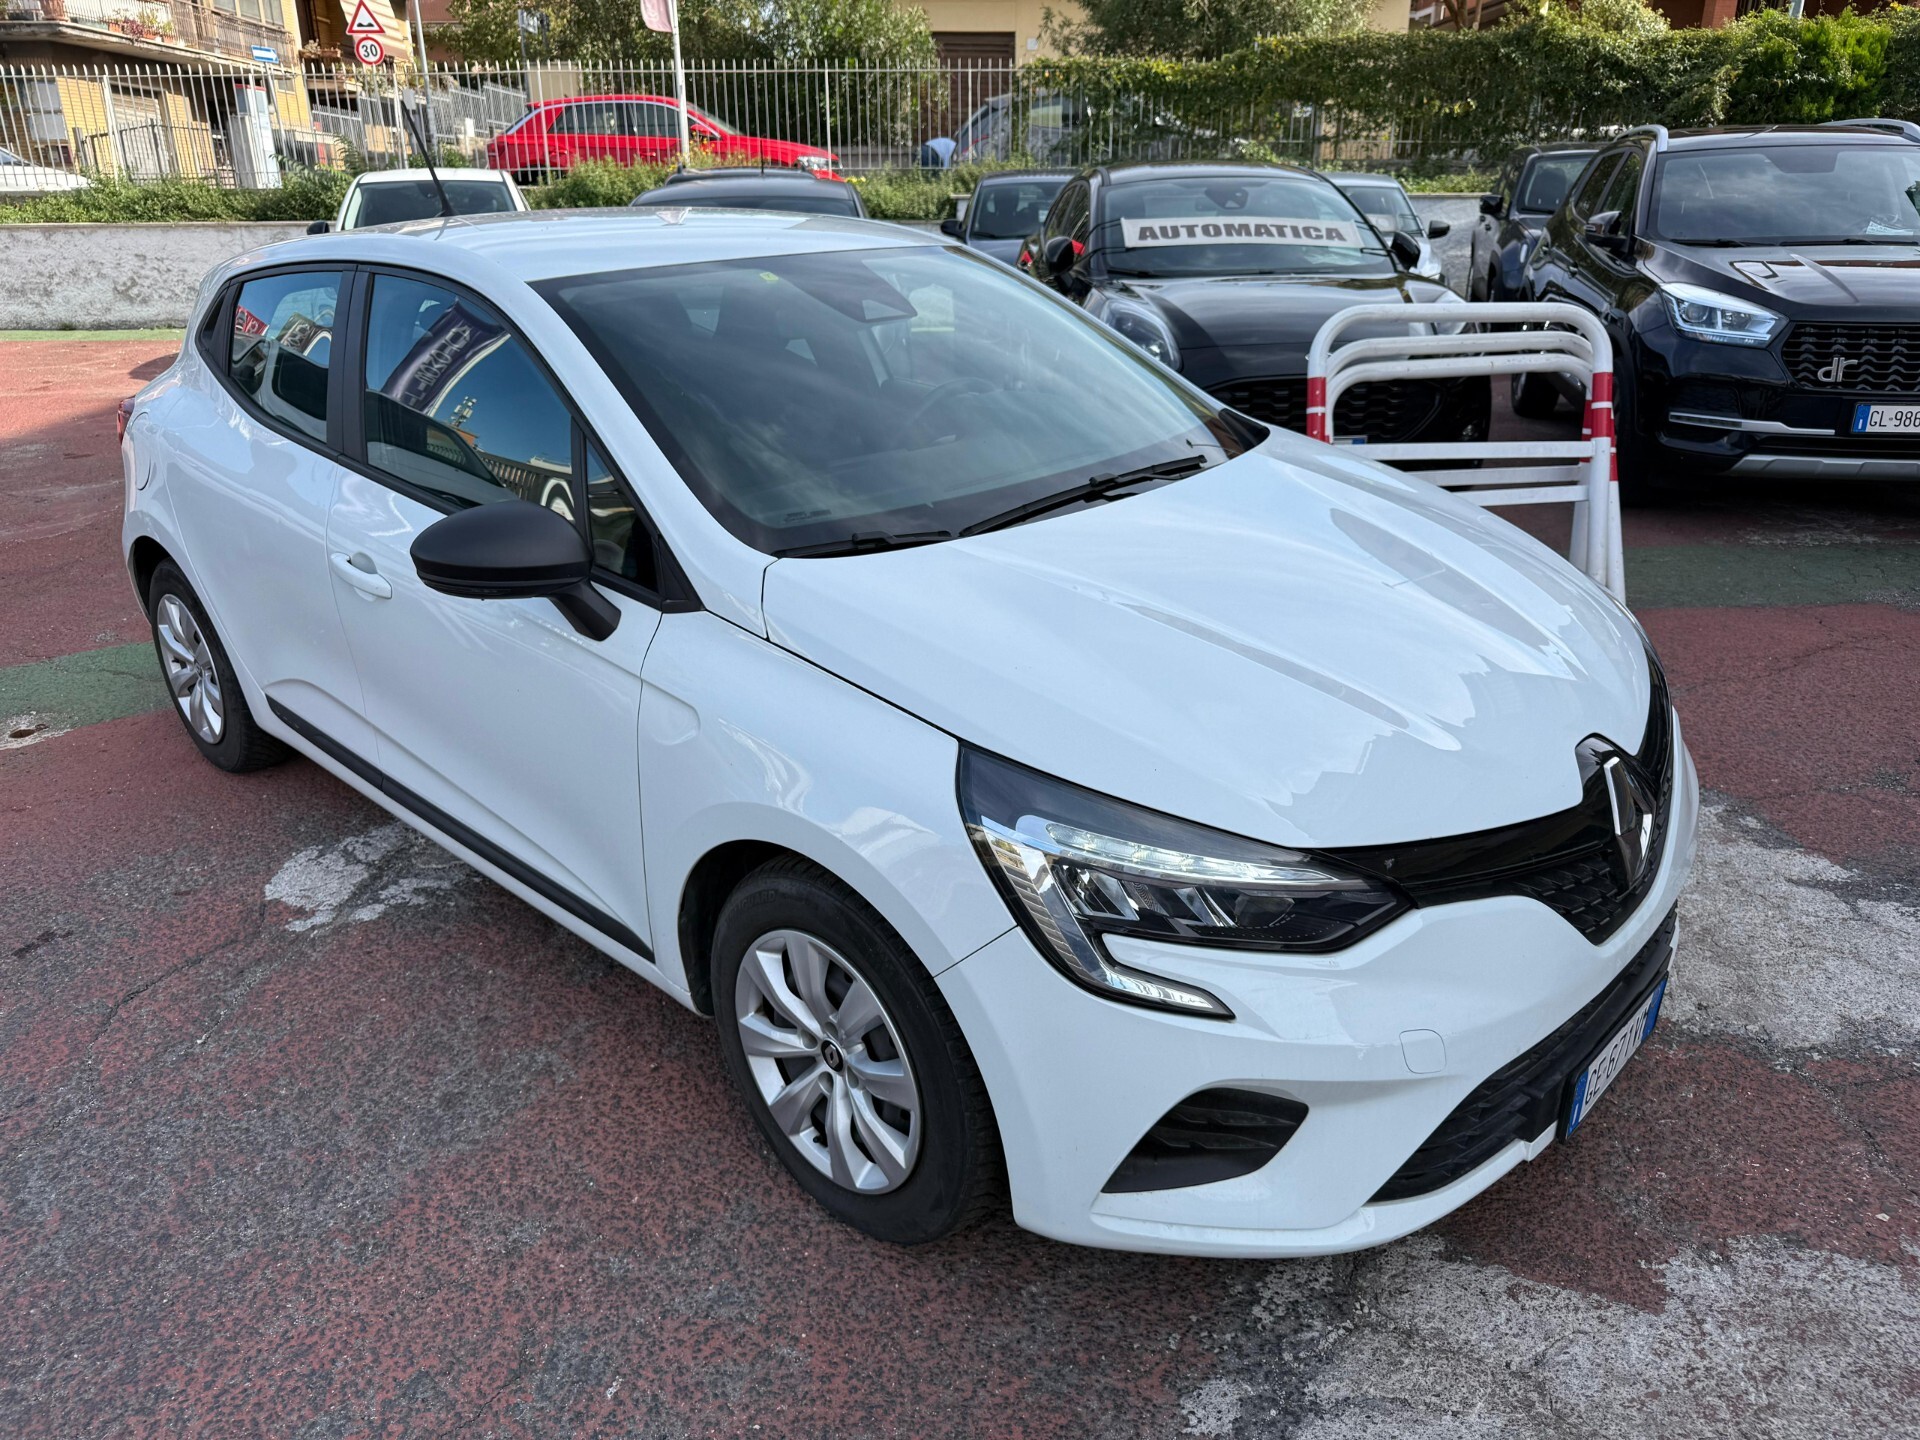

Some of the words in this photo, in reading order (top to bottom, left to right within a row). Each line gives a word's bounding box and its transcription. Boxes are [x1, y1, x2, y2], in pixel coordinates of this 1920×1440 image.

[361, 44, 378, 58] 30
[1138, 223, 1346, 241] AUTOMATICA
[1817, 357, 1858, 382] dr
